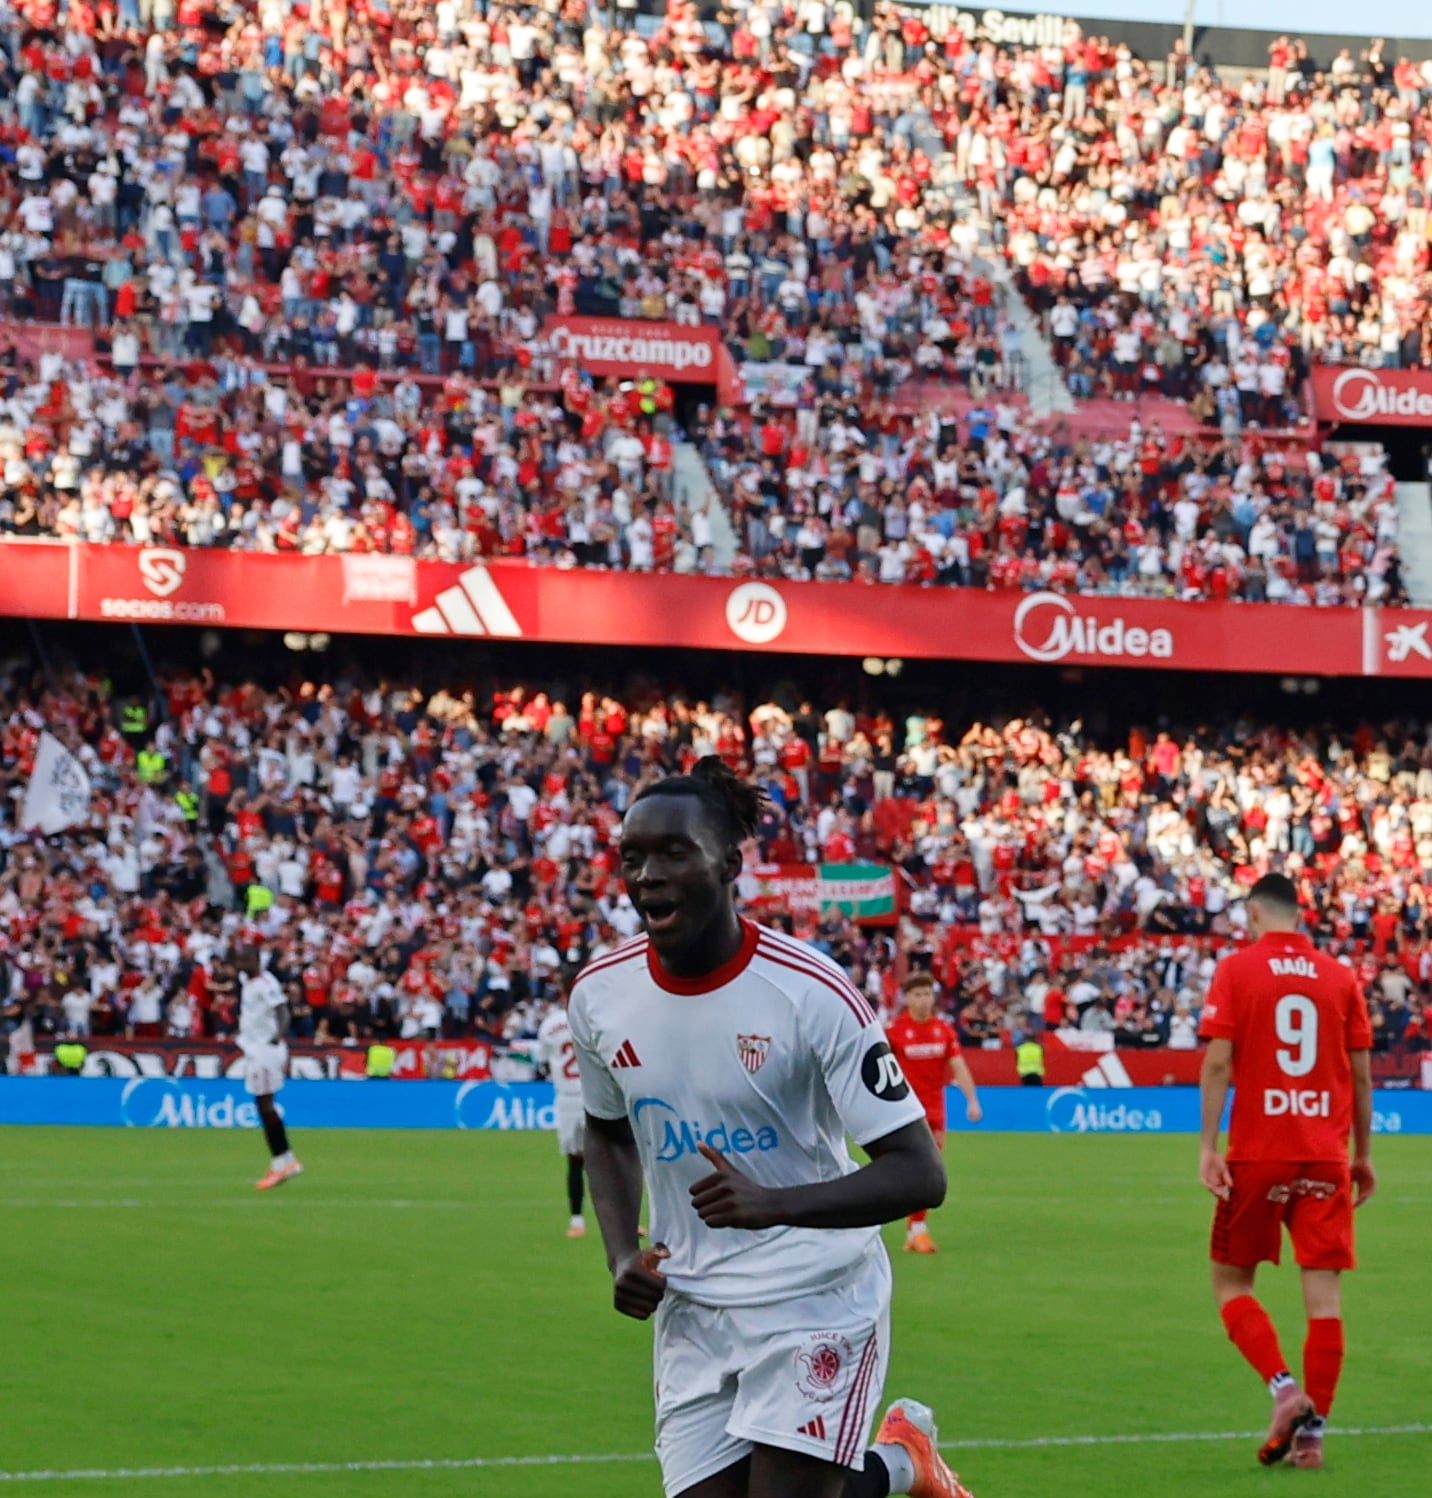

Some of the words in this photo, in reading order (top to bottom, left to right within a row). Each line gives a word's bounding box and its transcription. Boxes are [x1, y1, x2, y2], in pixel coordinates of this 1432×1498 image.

[549, 326, 713, 370] Cruzcampo
[1037, 613, 1174, 661] Midea
[1268, 956, 1319, 979] RAÚL
[1275, 993, 1318, 1078] 9
[873, 1051, 906, 1095] JD
[1067, 1102, 1163, 1132] Midea
[1264, 1088, 1330, 1118] DIGI
[655, 1118, 779, 1162] Midea
